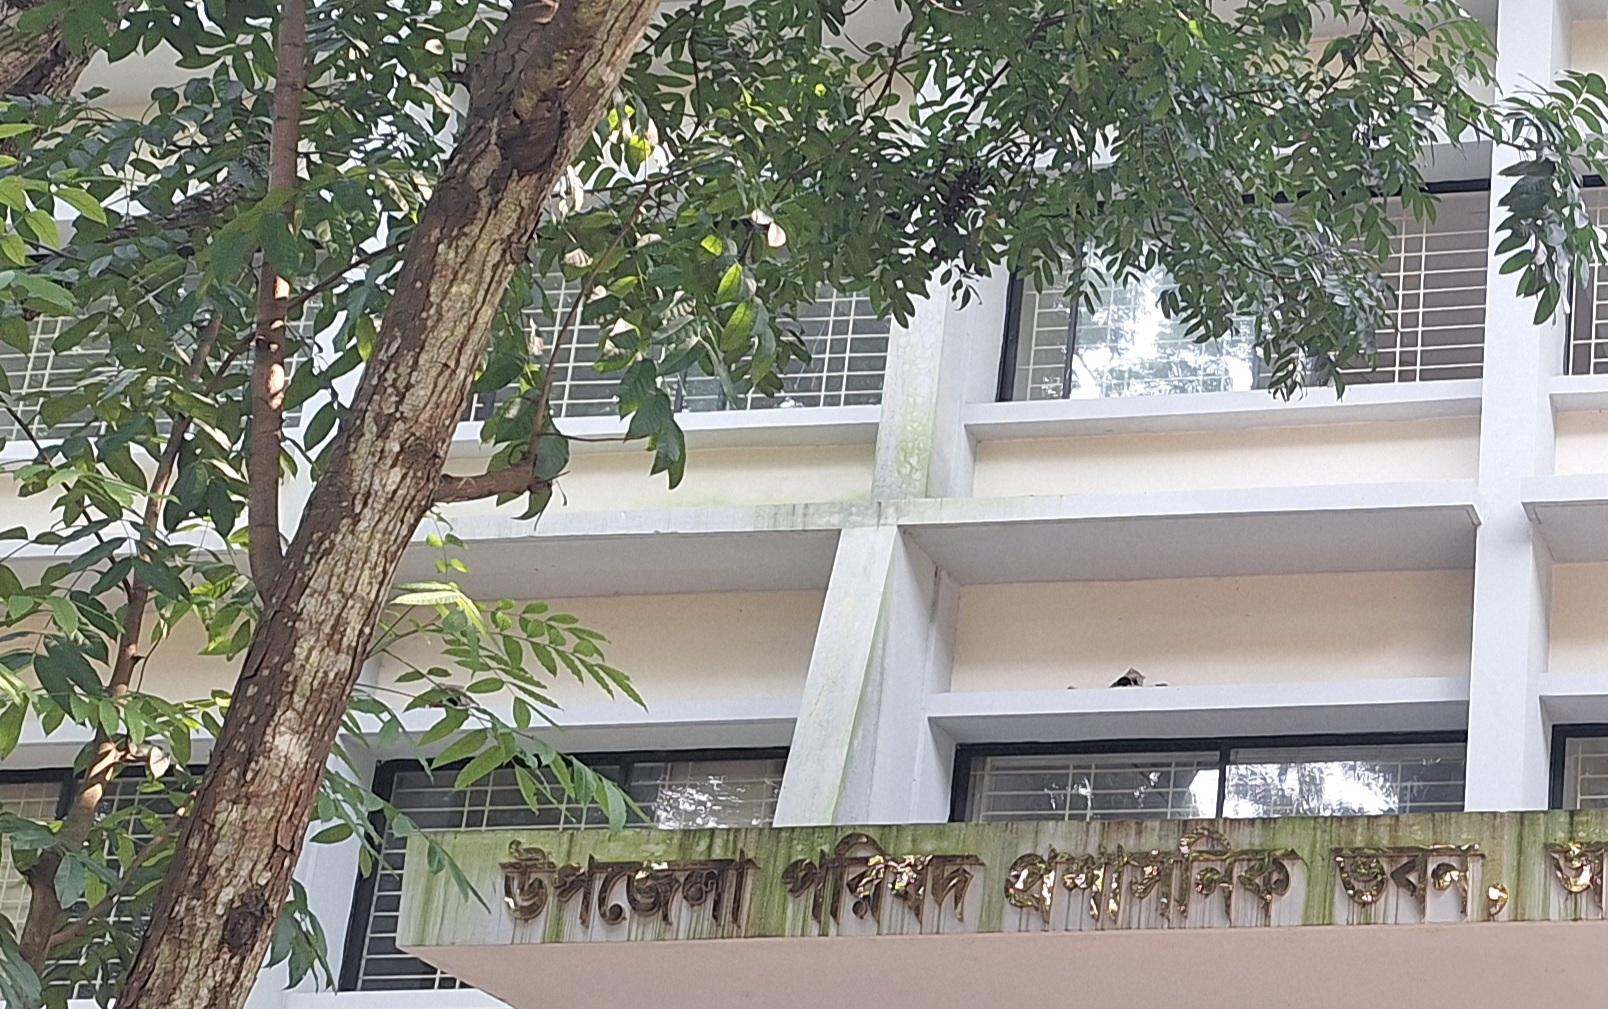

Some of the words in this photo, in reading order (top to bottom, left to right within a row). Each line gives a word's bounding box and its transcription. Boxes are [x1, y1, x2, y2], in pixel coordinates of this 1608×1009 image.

[499, 839, 760, 928] উপজেলা
[782, 832, 986, 926] পরিষদ
[1004, 826, 1306, 927] প্রশাসনিক
